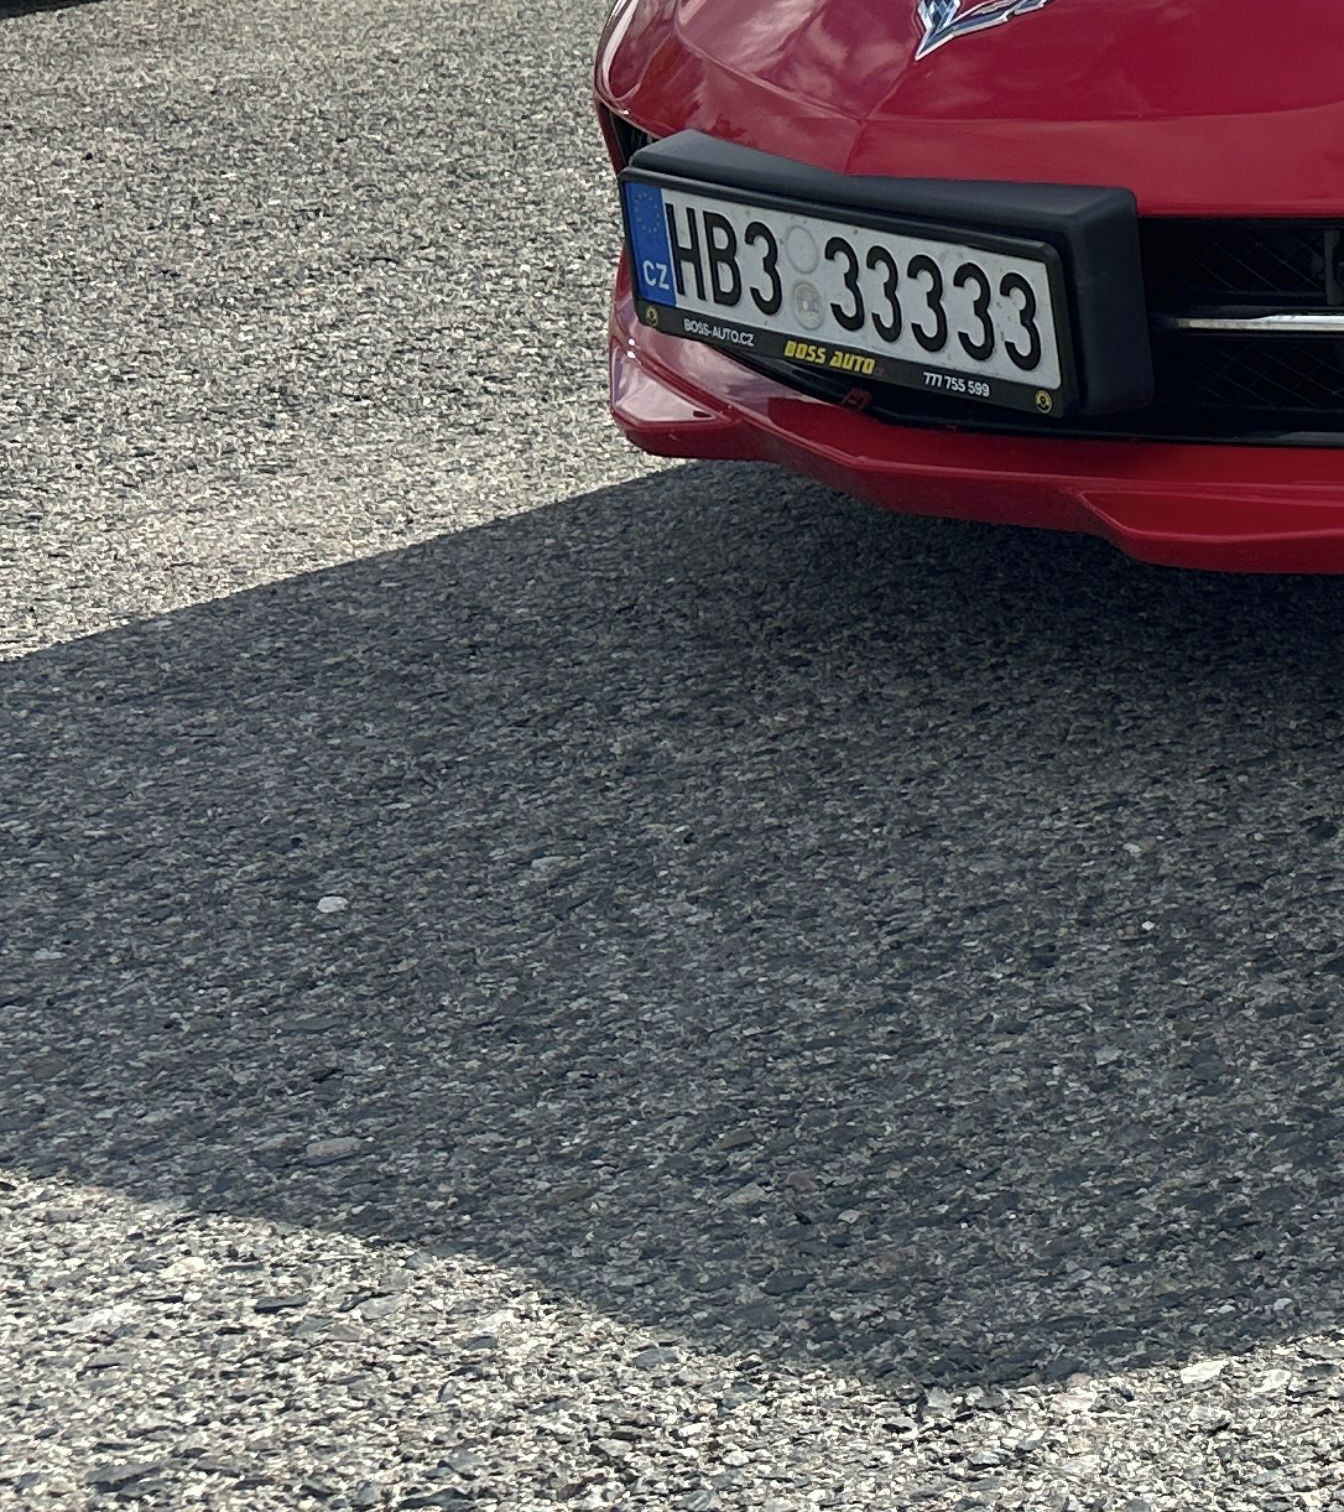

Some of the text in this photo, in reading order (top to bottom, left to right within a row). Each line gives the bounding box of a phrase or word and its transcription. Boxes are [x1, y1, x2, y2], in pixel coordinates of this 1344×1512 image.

[641, 202, 1043, 372] CZ HB3 33333
[683, 317, 755, 348] BOSS-AUTO.CZ
[783, 340, 827, 365] BOSS
[828, 350, 876, 376] AUTO
[922, 371, 991, 398] 777 755 599
